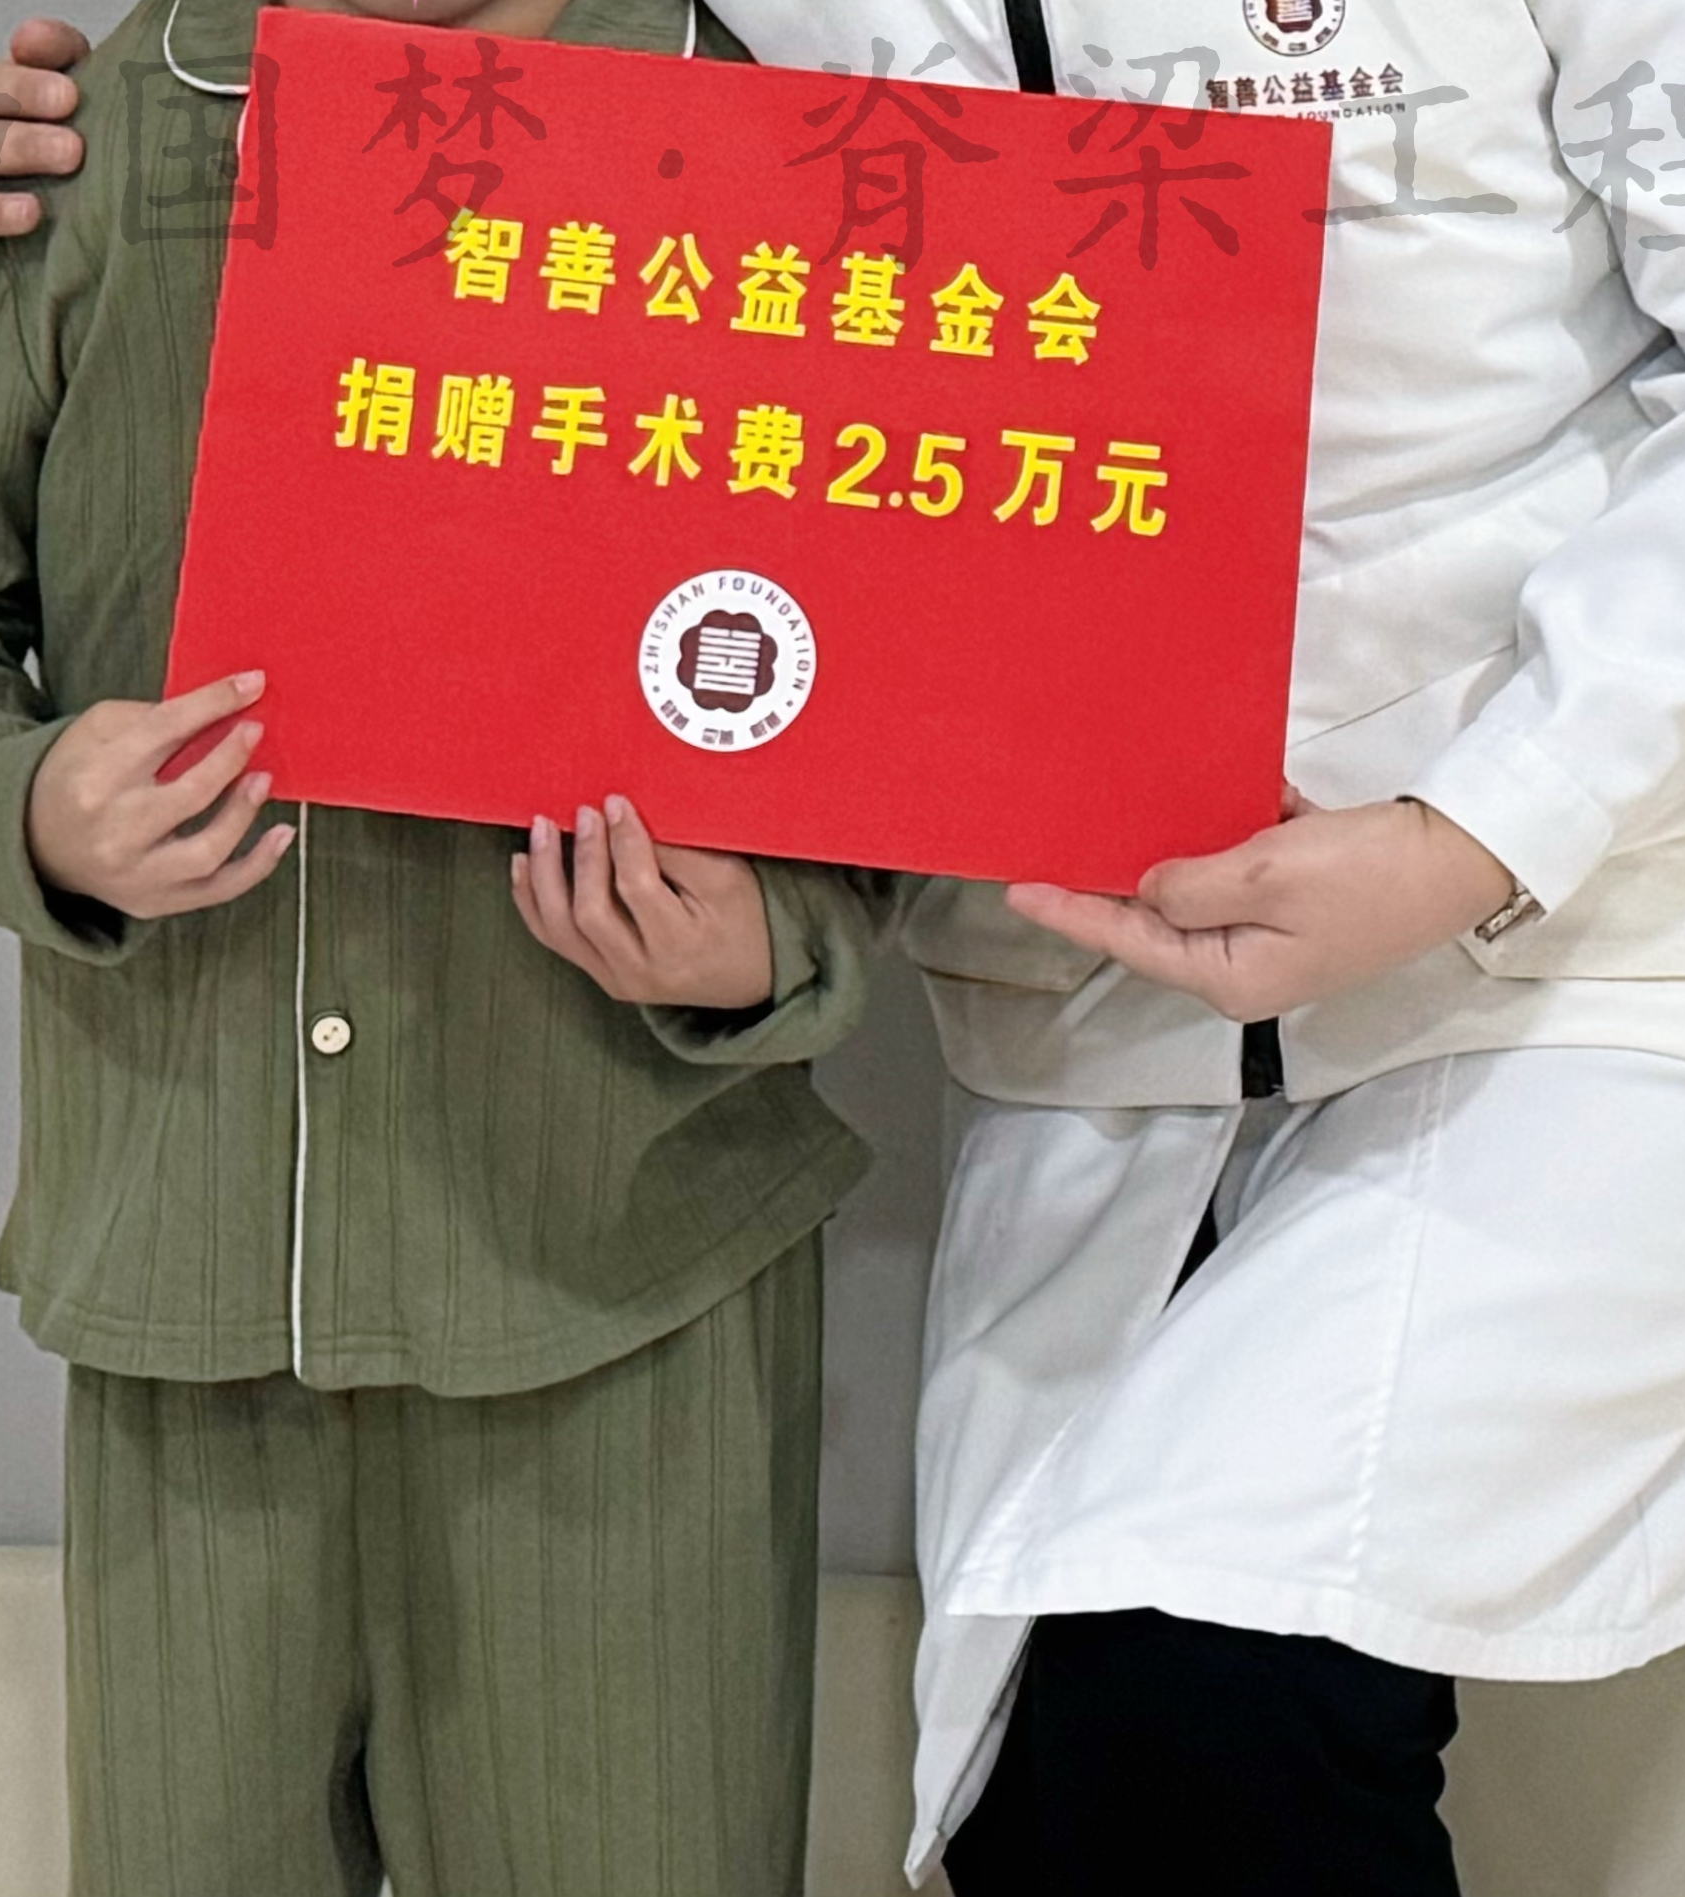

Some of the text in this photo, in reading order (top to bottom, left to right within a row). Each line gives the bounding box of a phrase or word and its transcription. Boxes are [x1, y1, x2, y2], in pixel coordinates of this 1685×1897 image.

[1204, 61, 1404, 110] 智善公益基金会
[444, 208, 1102, 368] 智善公益基金会
[333, 356, 1172, 540] 捐赠手术费2.5万元
[644, 575, 811, 691] ZHISHAN FOUNDATION
